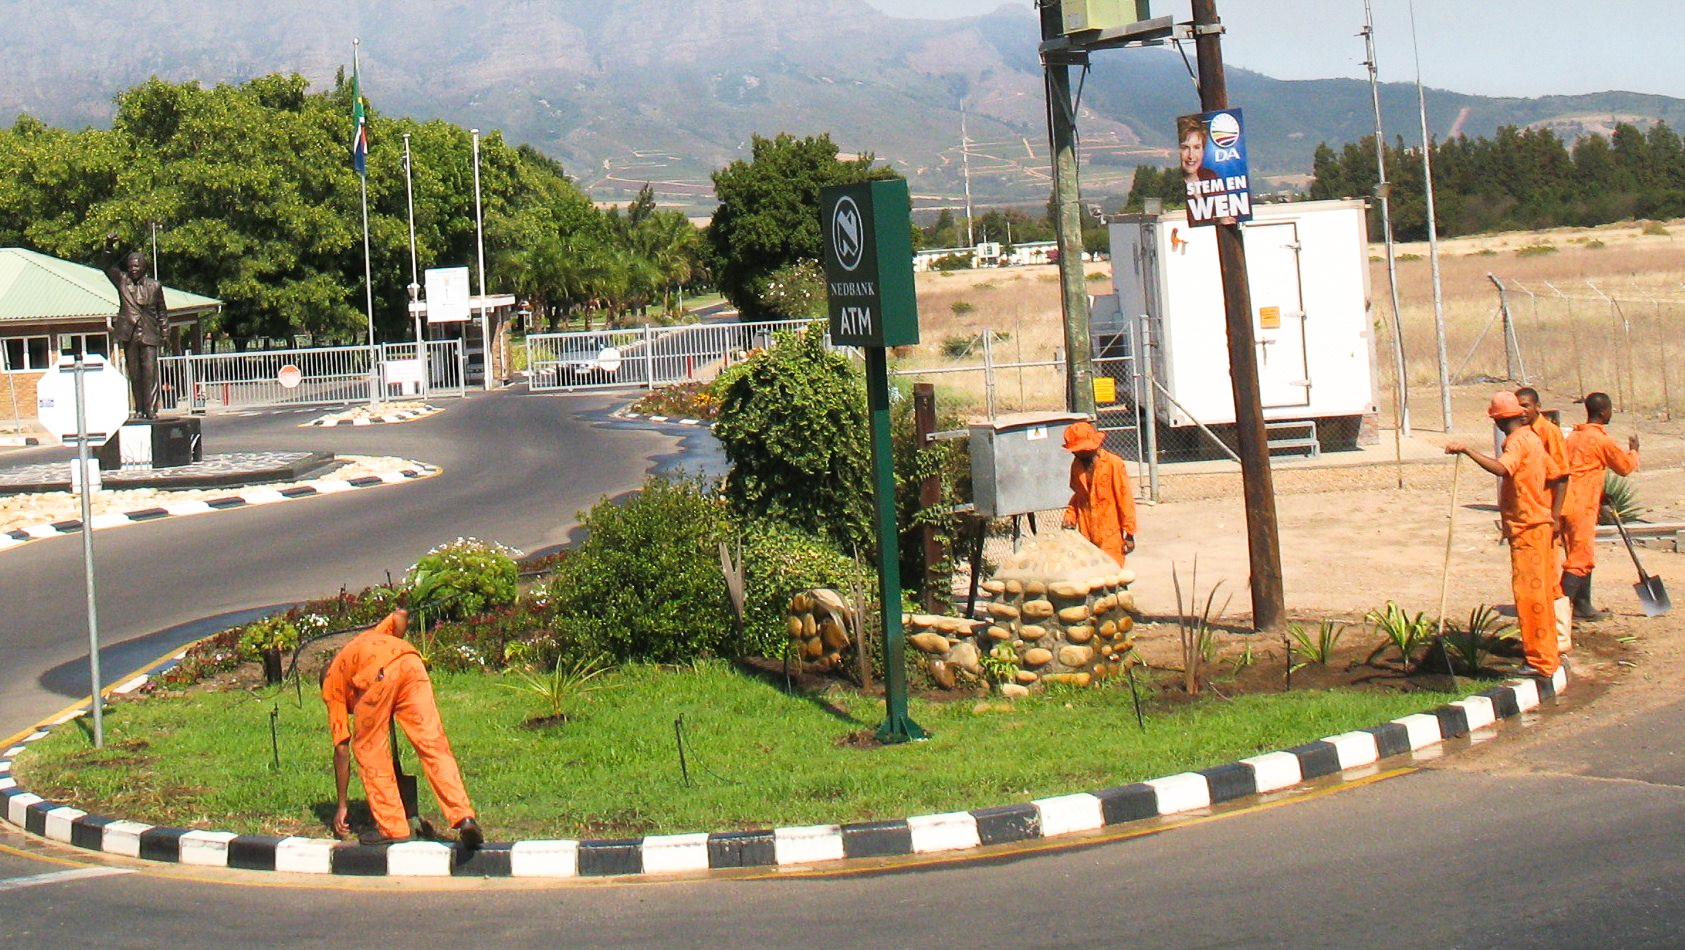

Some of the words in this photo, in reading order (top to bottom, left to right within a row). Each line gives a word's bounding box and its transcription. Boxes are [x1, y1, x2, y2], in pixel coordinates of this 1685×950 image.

[1215, 148, 1240, 162] DA
[1186, 179, 1225, 195] STEM
[1226, 175, 1247, 190] EN
[1187, 192, 1250, 221] WEN
[831, 282, 875, 296] NEDBANK
[840, 306, 872, 335] ATM
